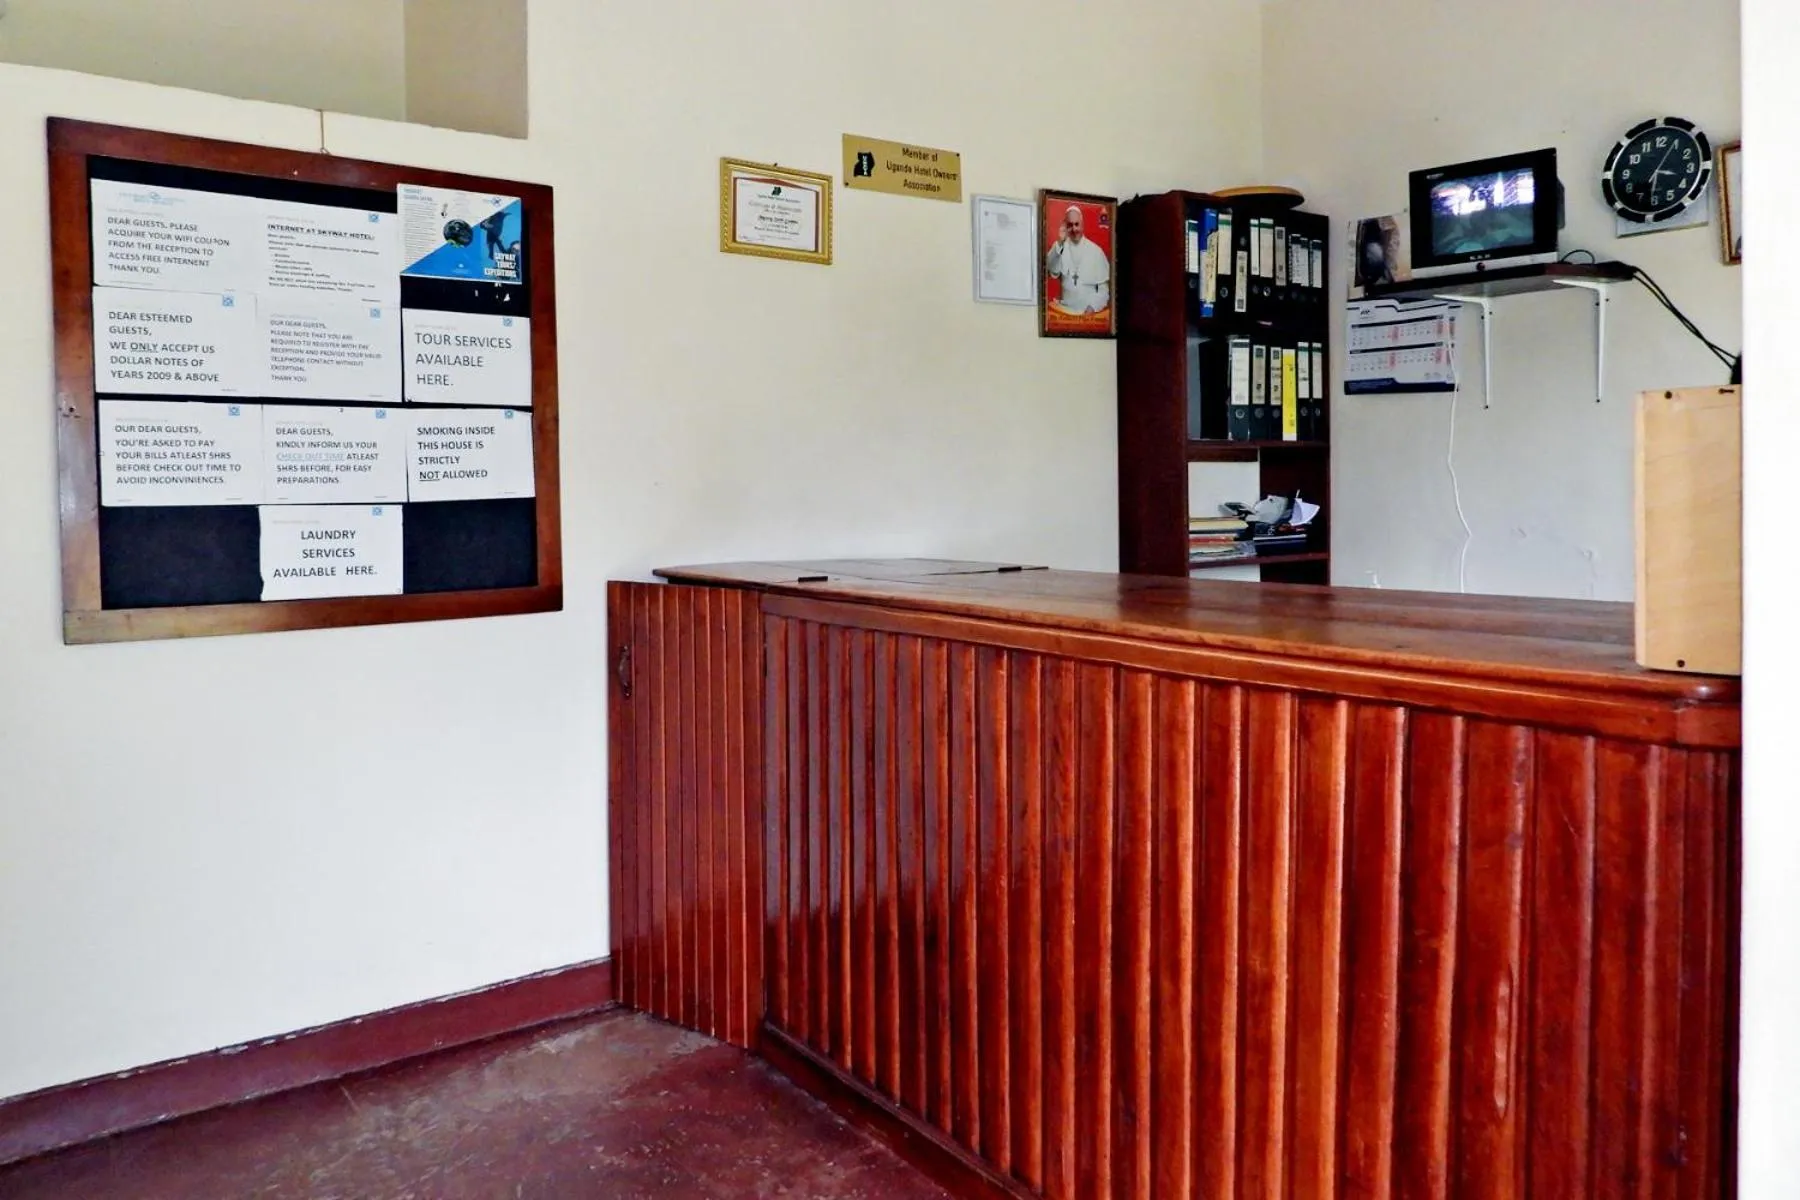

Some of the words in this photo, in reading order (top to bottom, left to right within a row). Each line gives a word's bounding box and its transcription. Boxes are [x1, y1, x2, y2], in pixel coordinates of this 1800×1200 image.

[1642, 142, 1651, 152] 11
[1655, 137, 1667, 148] 12
[902, 147, 929, 160] Member
[932, 153, 938, 161] of
[1629, 154, 1640, 164] 10
[1683, 149, 1691, 159] 2
[886, 160, 912, 173] Uganda
[914, 164, 931, 177] Hotel
[1687, 163, 1694, 173] 3
[1622, 169, 1630, 179] 9
[904, 179, 941, 192] Association
[1679, 178, 1687, 188] 4
[1666, 190, 1674, 201] 5
[170, 222, 198, 232] PLEASE
[268, 224, 304, 234] INTERNET
[108, 228, 145, 238] ACQUIRE
[149, 232, 172, 240] YOUR
[175, 235, 192, 243] WIFI
[109, 240, 134, 248] FROM
[137, 242, 151, 250] THE
[156, 243, 200, 255] RECEPTION
[203, 248, 213, 256] TO
[109, 252, 140, 260] ACCESS
[142, 254, 161, 263] FREE
[110, 264, 138, 272] THANK
[109, 312, 136, 320] DEAR
[140, 313, 192, 323] ESTEEMED
[109, 326, 152, 336] GUESTS,
[414, 332, 451, 345] TOUR
[455, 335, 512, 348] SERVICES
[110, 342, 126, 350] WE
[130, 342, 158, 352] ONLY
[162, 343, 199, 352] ACCEPT
[201, 345, 215, 354] US
[110, 356, 151, 365] DOLLAR
[155, 358, 188, 366] NOTES
[416, 353, 484, 367] AVAILABLE
[111, 370, 144, 379] YEARS
[147, 372, 171, 380] 2009
[174, 372, 182, 380] &
[186, 373, 220, 382] ABOVE
[417, 374, 454, 386] HERE.
[417, 427, 463, 435] SMOKING
[465, 426, 495, 435] INSIDE
[418, 456, 460, 464] STRICTLY
[420, 471, 440, 481] NOT
[443, 470, 488, 479] ALLOWED
[301, 530, 356, 540] LAUNDRY
[302, 548, 355, 558] SERVICES
[273, 566, 336, 578] AVAILABLE
[346, 566, 378, 575] HERE.
